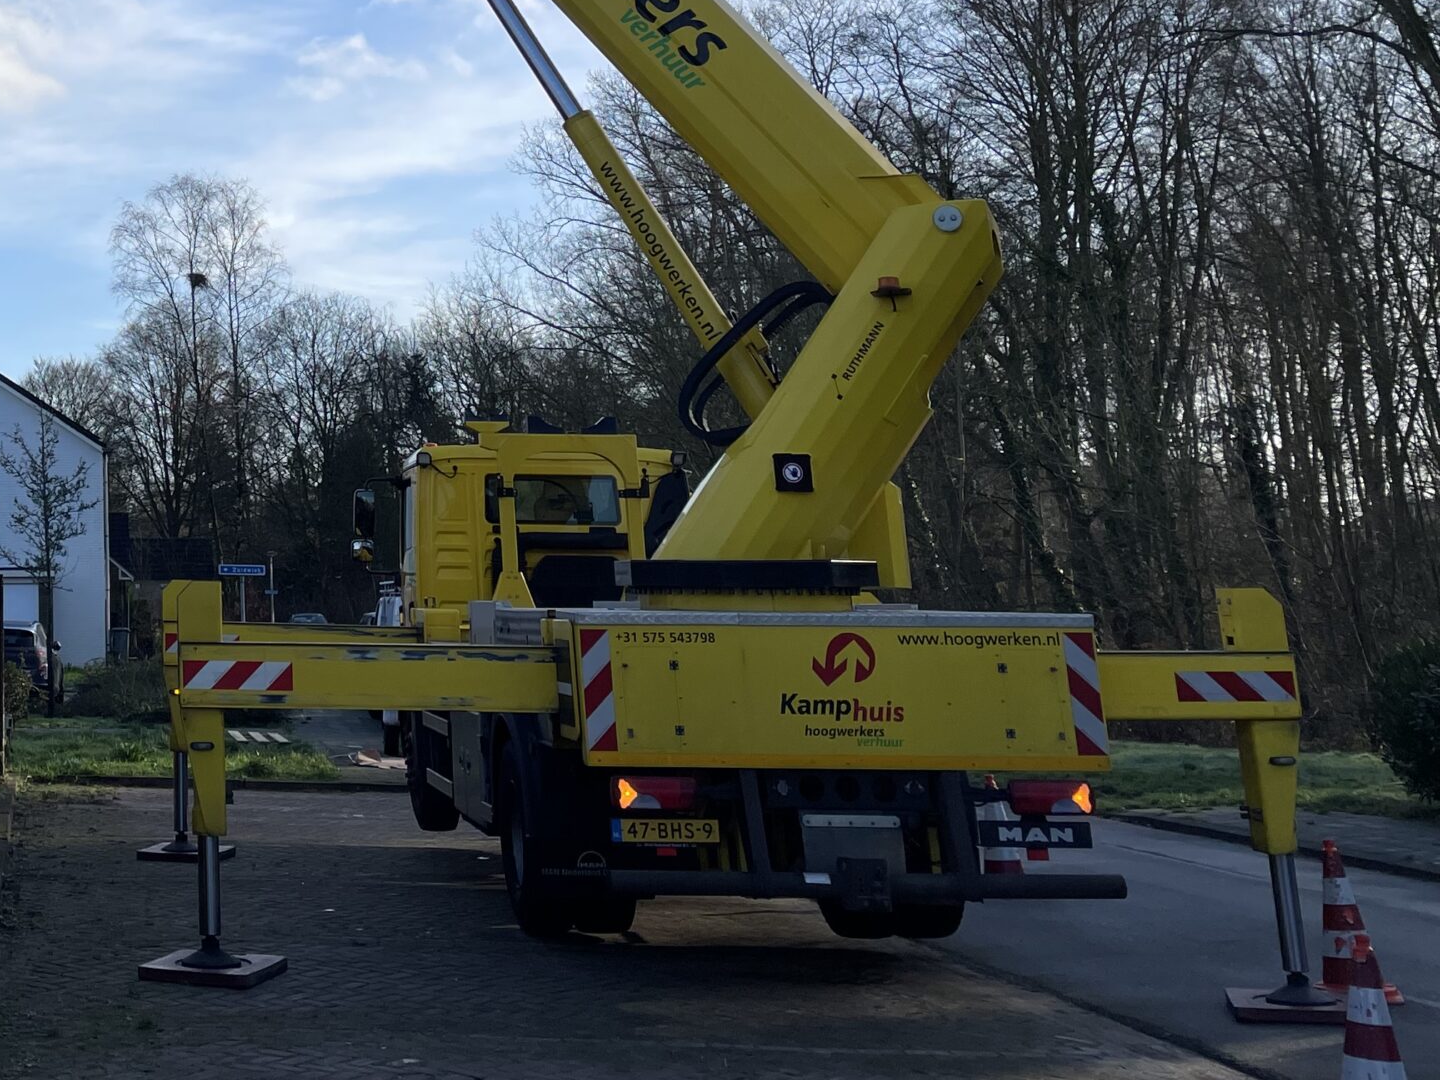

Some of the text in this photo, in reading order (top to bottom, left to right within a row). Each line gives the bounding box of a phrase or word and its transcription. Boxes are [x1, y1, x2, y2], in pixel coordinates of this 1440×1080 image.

[620, 7, 708, 92] verhuur
[600, 160, 723, 342] www.hoogwerken.nl
[841, 320, 886, 381] RUTHMANN
[615, 631, 716, 643] +31 575 543798
[897, 631, 1060, 650] www.hoogwerken.nl
[780, 692, 905, 723] Kamphuis
[804, 724, 886, 739] hoogwerkers
[857, 735, 904, 747] verhuur
[626, 822, 713, 839] 47-BHS-9
[997, 826, 1074, 843] MAN
